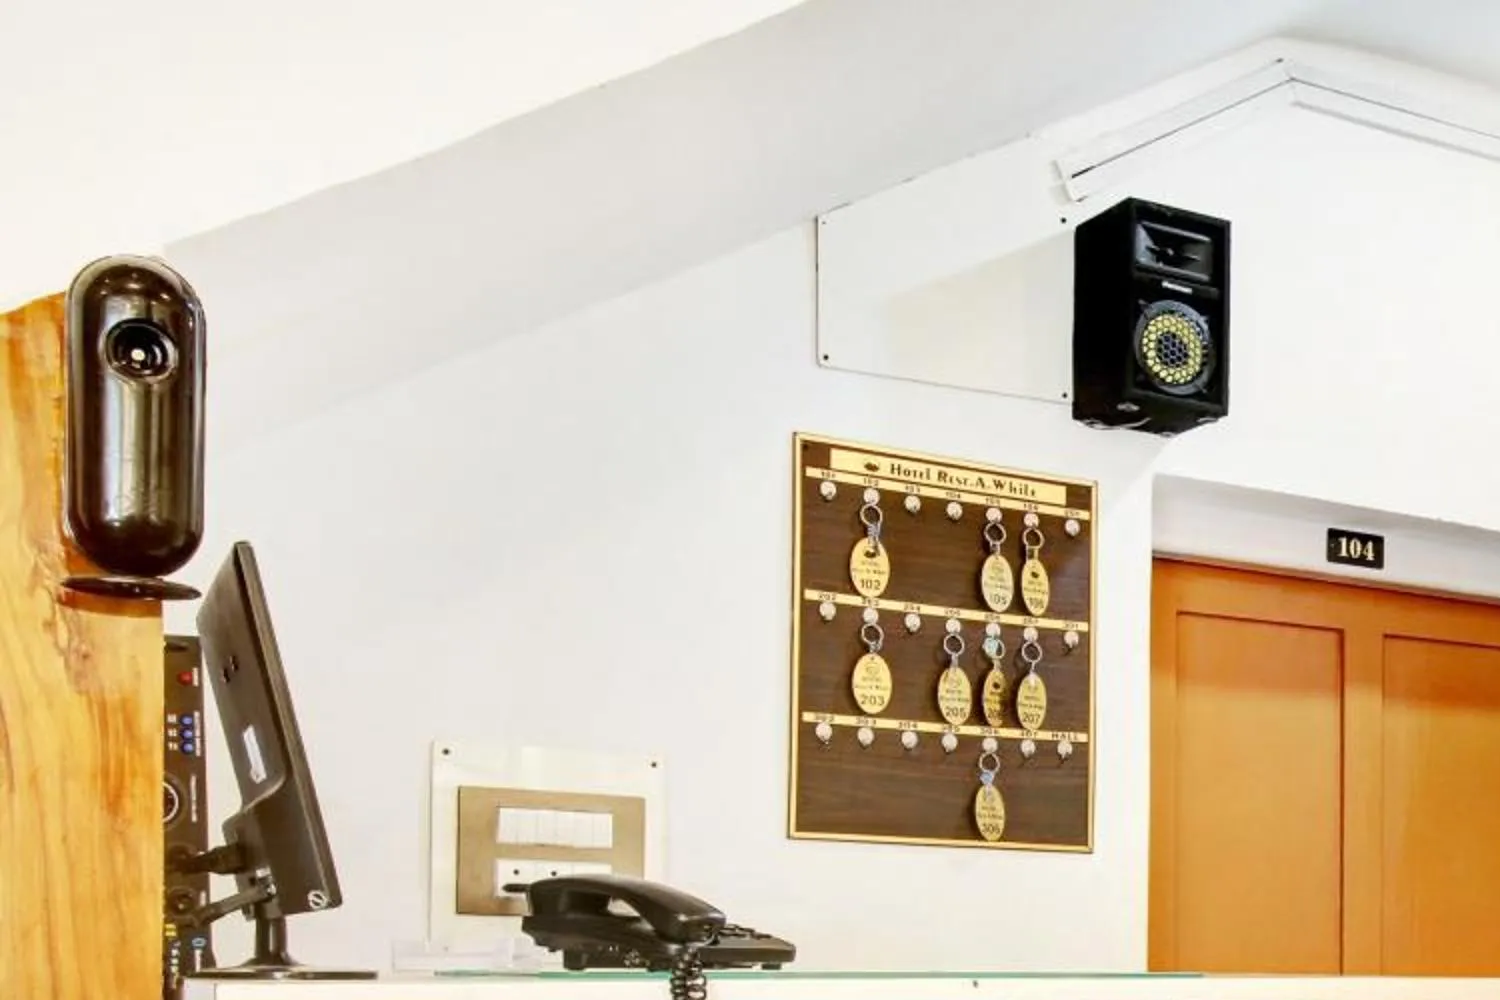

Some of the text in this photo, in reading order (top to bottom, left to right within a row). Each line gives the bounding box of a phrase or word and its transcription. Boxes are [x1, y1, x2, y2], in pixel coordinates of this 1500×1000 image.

[1337, 536, 1375, 561] 104
[860, 578, 882, 591] 102
[860, 693, 885, 706] 203
